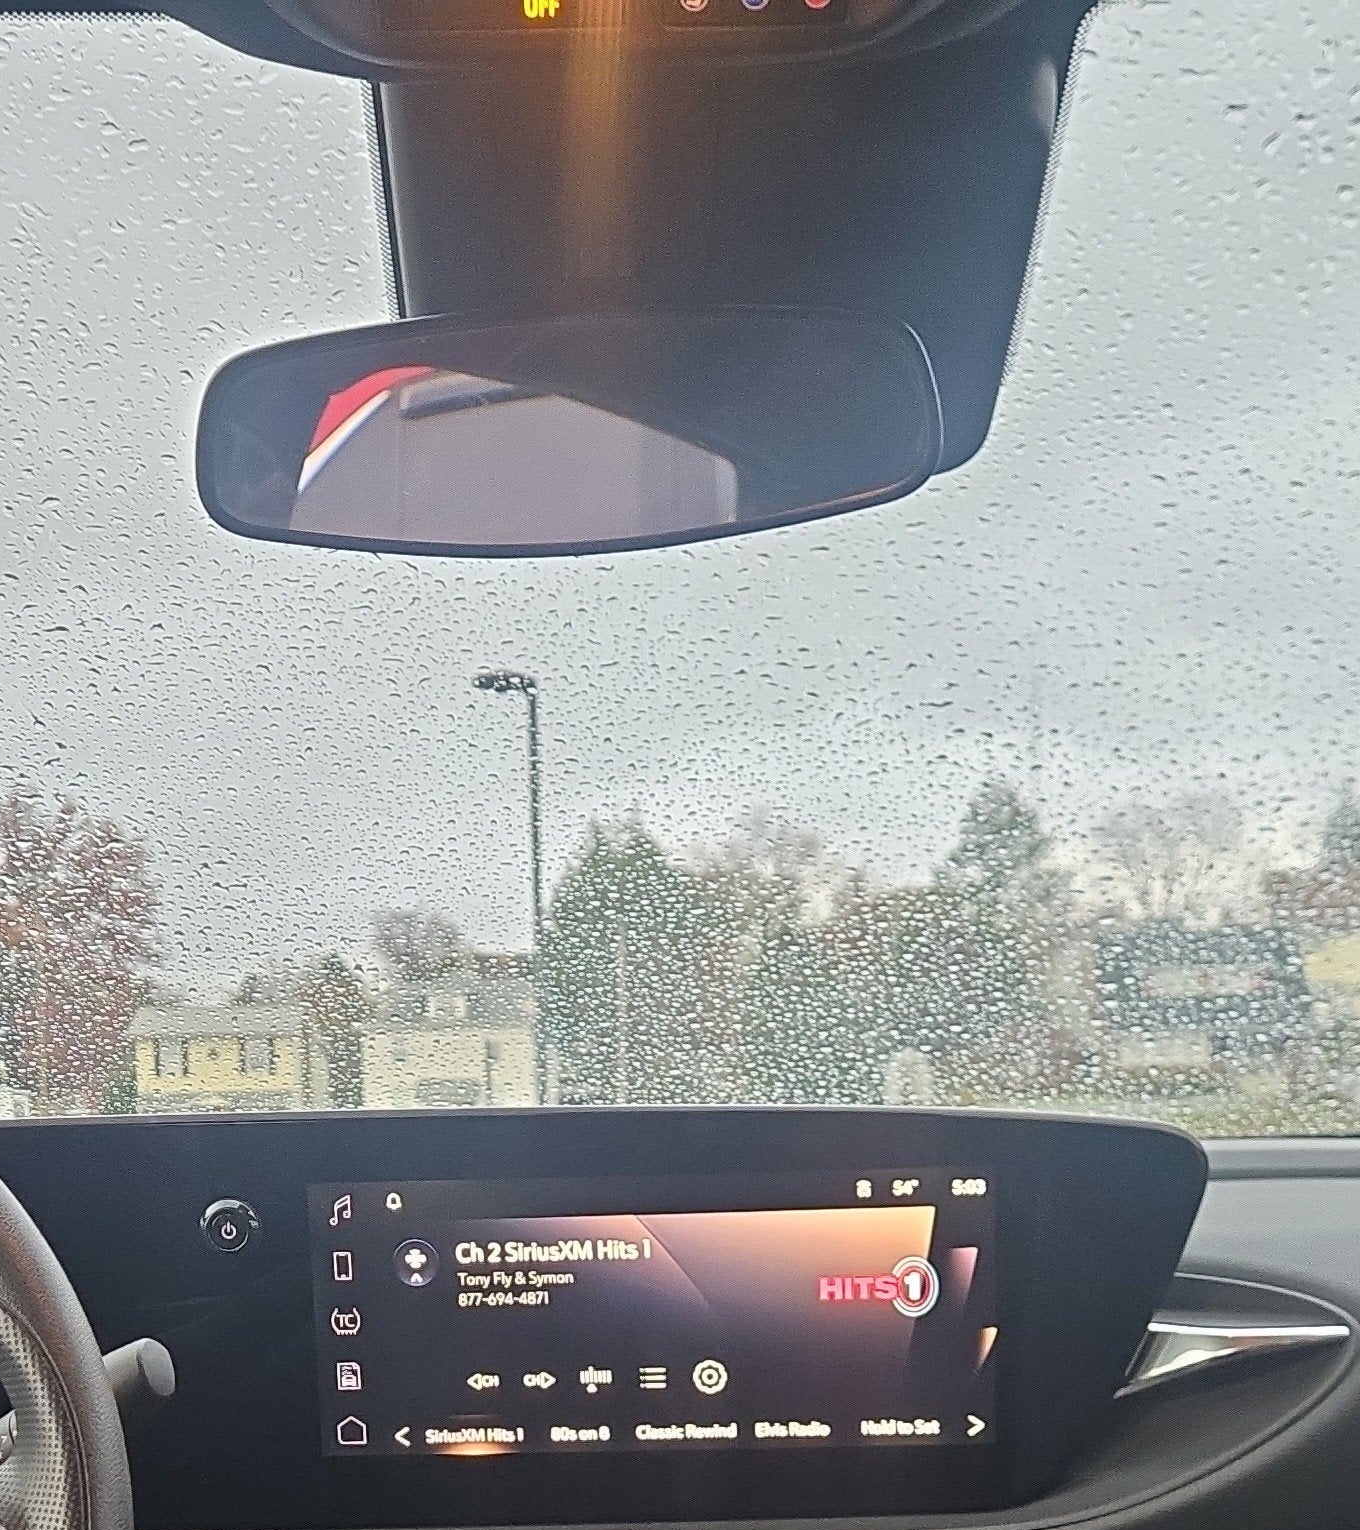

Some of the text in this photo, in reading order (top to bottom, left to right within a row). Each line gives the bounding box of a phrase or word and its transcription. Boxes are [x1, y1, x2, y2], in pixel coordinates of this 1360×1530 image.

[455, 1239, 651, 1265] Ch 2 SiriusXM Hits 1
[457, 1271, 574, 1289] Tony Fly & Symon
[819, 1271, 922, 1301] HITS 1
[458, 1291, 549, 1307] 877-694-4871
[336, 1314, 356, 1329] TC
[482, 1374, 500, 1388] CH
[425, 1427, 486, 1444] SiriusXM
[486, 1427, 516, 1443] Hits
[635, 1423, 738, 1440] Classic Rewind
[788, 1420, 831, 1437] Radio
[860, 1418, 941, 1436] Hold to Set
